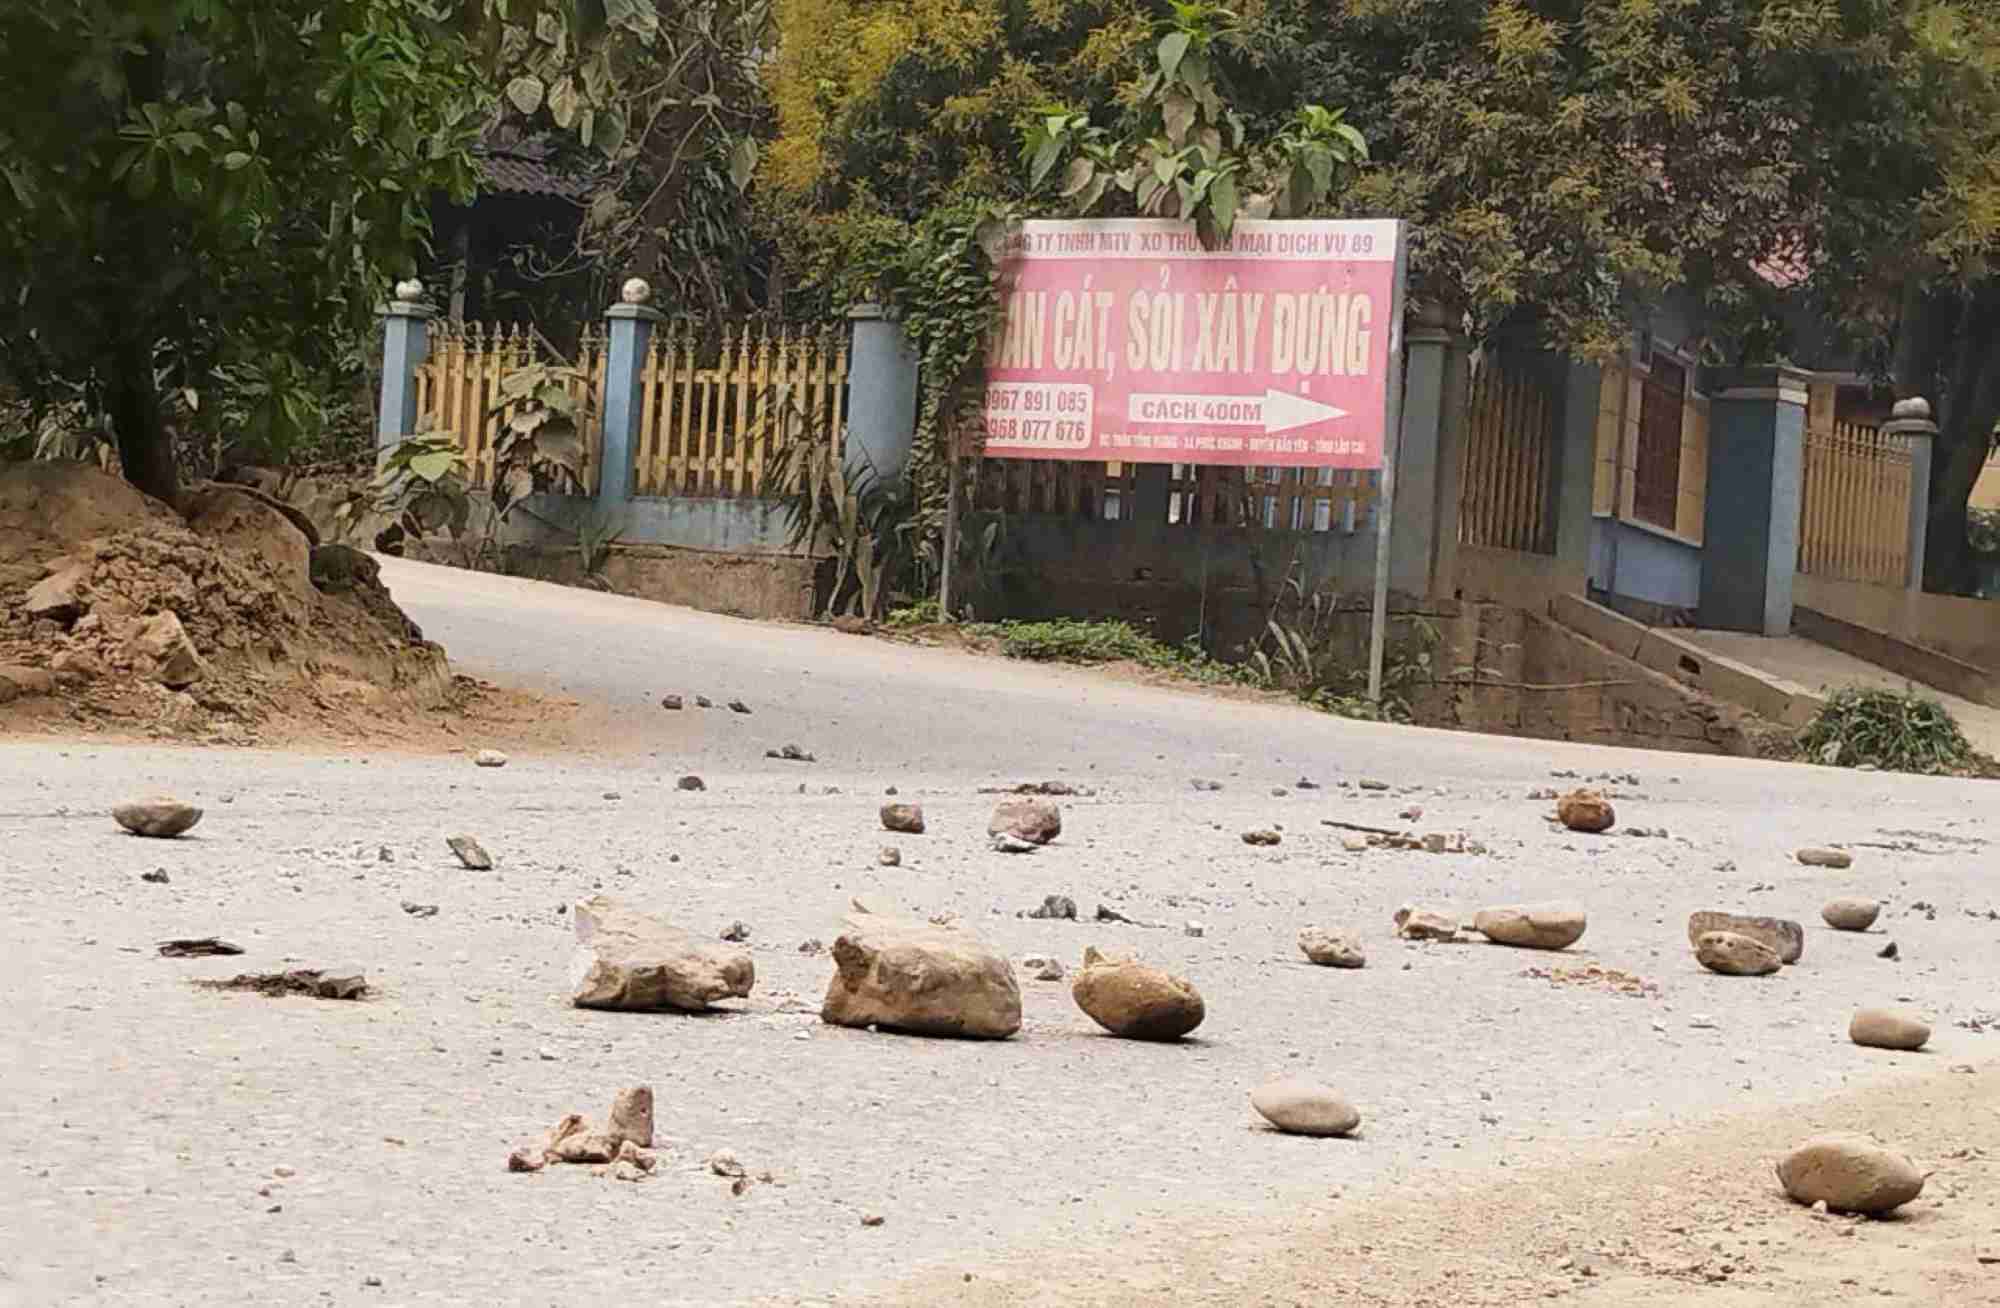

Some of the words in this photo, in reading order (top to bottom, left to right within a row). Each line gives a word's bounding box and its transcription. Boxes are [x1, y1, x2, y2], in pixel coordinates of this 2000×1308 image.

[1037, 232, 1053, 252] TY
[1057, 232, 1095, 252] TNHH
[1352, 234, 1374, 253] 89
[1053, 273, 1117, 382] CÁT,
[1126, 263, 1185, 371] SỎI
[1191, 274, 1265, 374] XÂY
[1024, 390, 1051, 412] 891
[1057, 391, 1088, 412] 085
[1203, 402, 1262, 421] 400M
[1023, 419, 1051, 440] 077
[1056, 421, 1085, 441] 676
